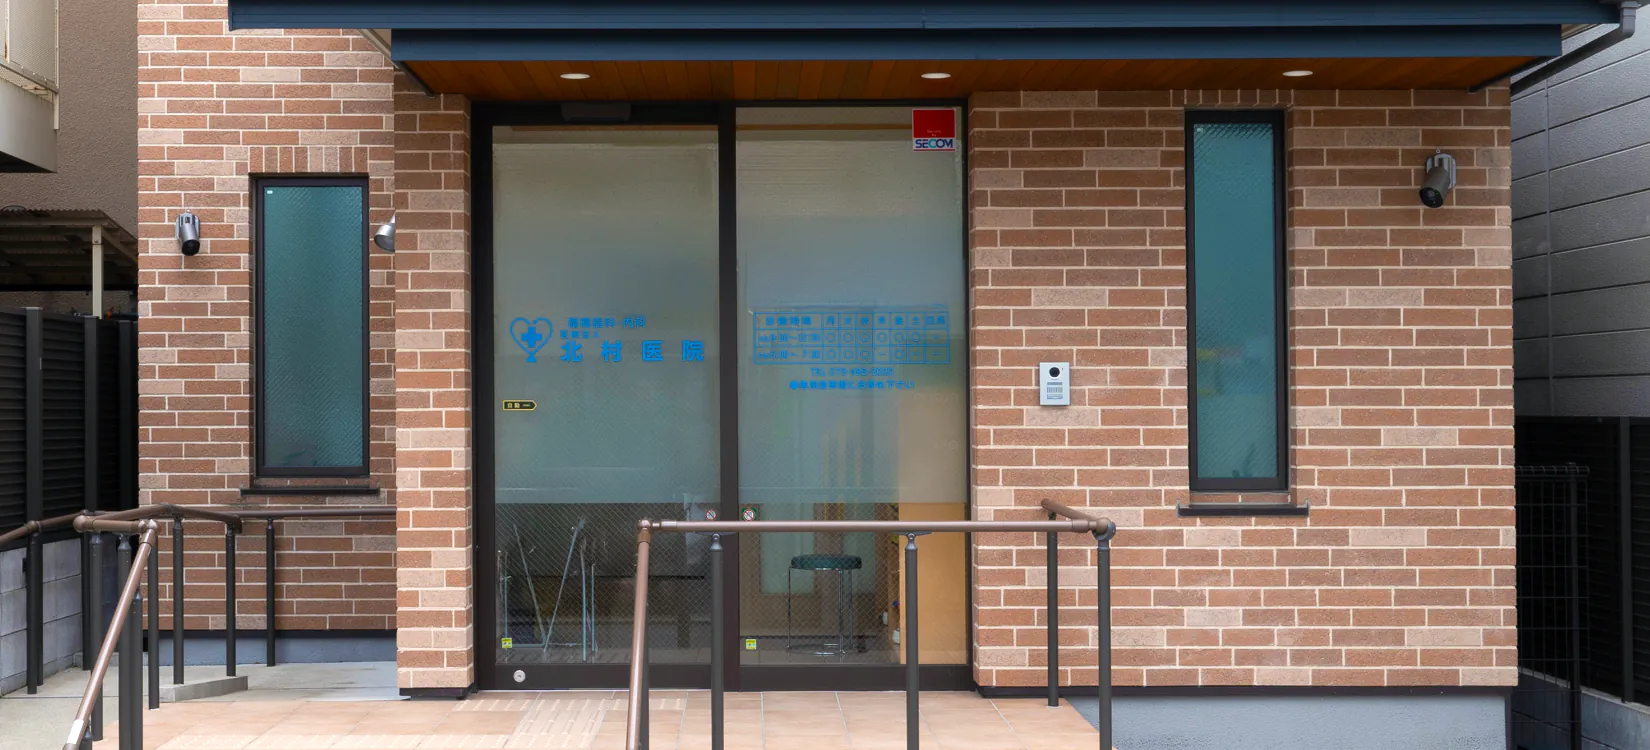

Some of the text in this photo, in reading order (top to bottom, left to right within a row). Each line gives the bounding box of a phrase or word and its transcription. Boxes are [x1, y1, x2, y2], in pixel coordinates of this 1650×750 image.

[915, 138, 954, 149] SECOM
[560, 340, 705, 362] 北村医院
